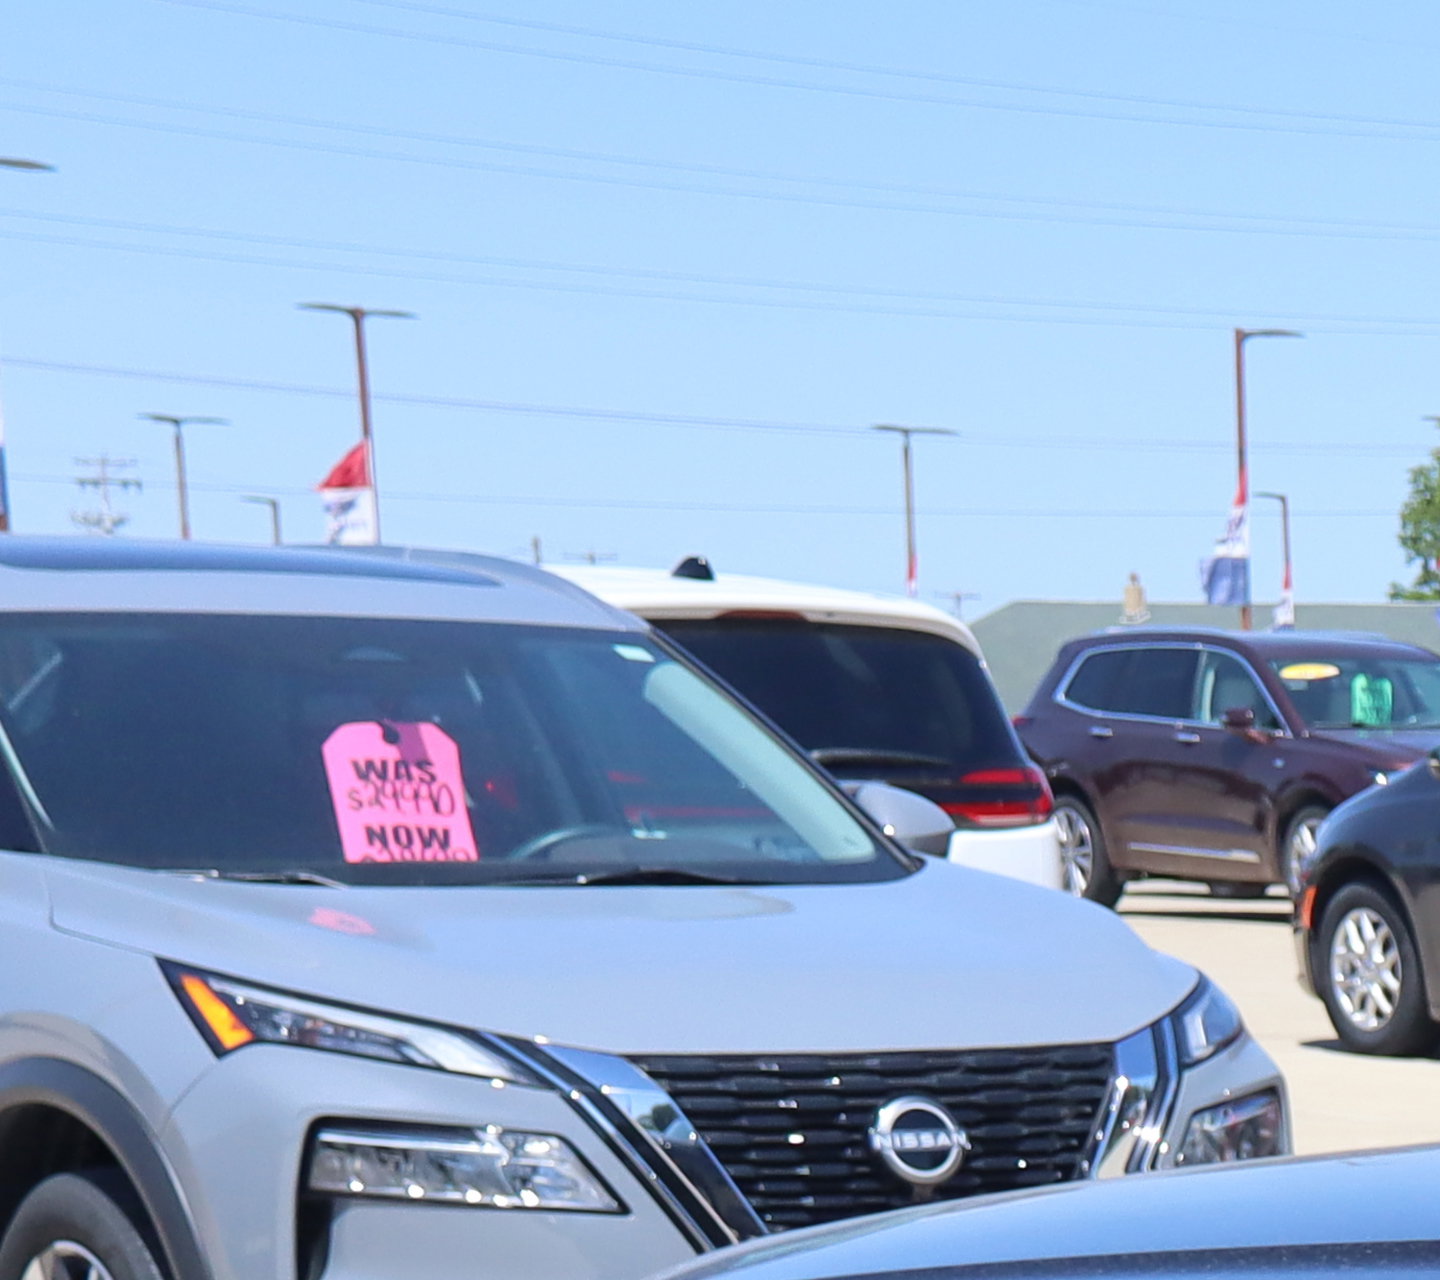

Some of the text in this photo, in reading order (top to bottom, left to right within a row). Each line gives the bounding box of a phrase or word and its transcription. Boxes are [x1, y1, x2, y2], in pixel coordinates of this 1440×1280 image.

[352, 759, 437, 785] WAS
[365, 825, 451, 850] NOW
[868, 1127, 972, 1151] NISSAN
